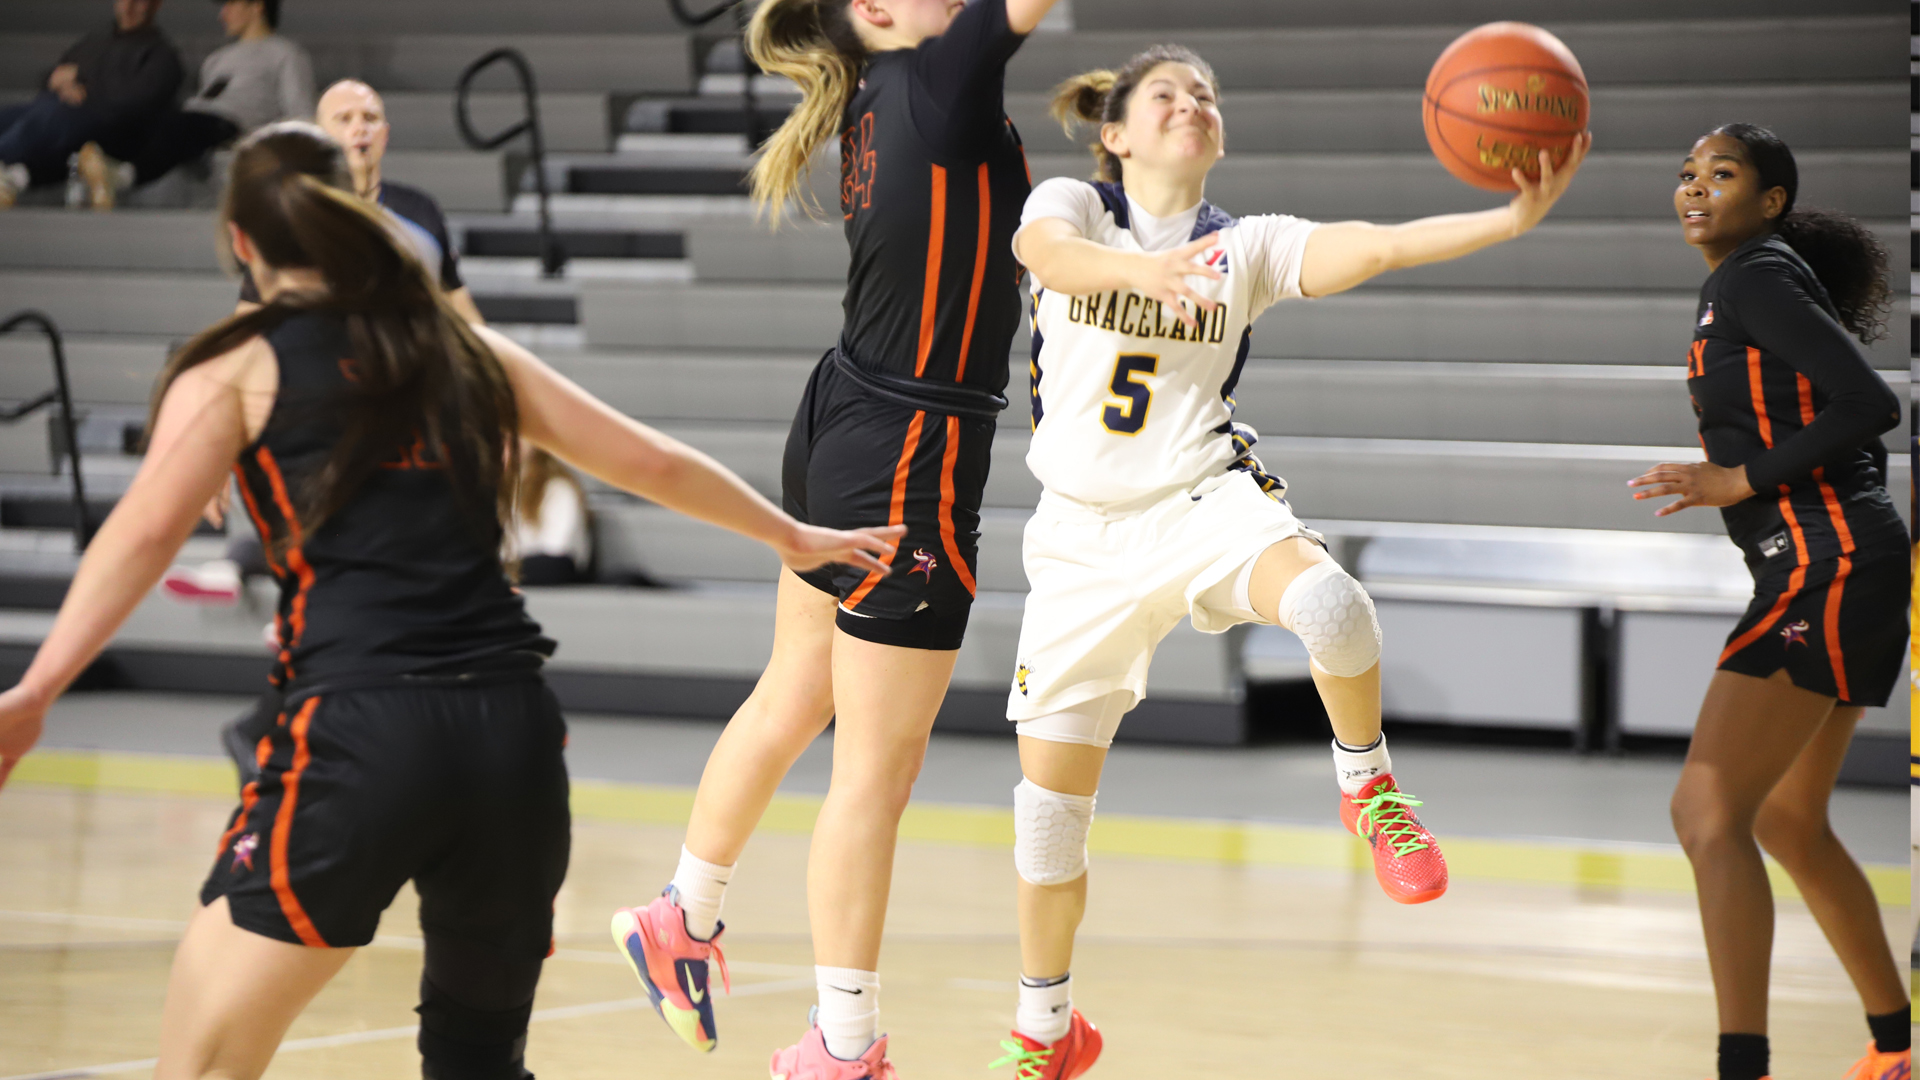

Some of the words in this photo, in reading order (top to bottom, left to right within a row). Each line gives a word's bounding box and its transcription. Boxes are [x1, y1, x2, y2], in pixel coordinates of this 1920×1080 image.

[1477, 82, 1578, 123] SPALDING
[1068, 289, 1228, 344] GRACELAND
[1099, 352, 1160, 437] 5
